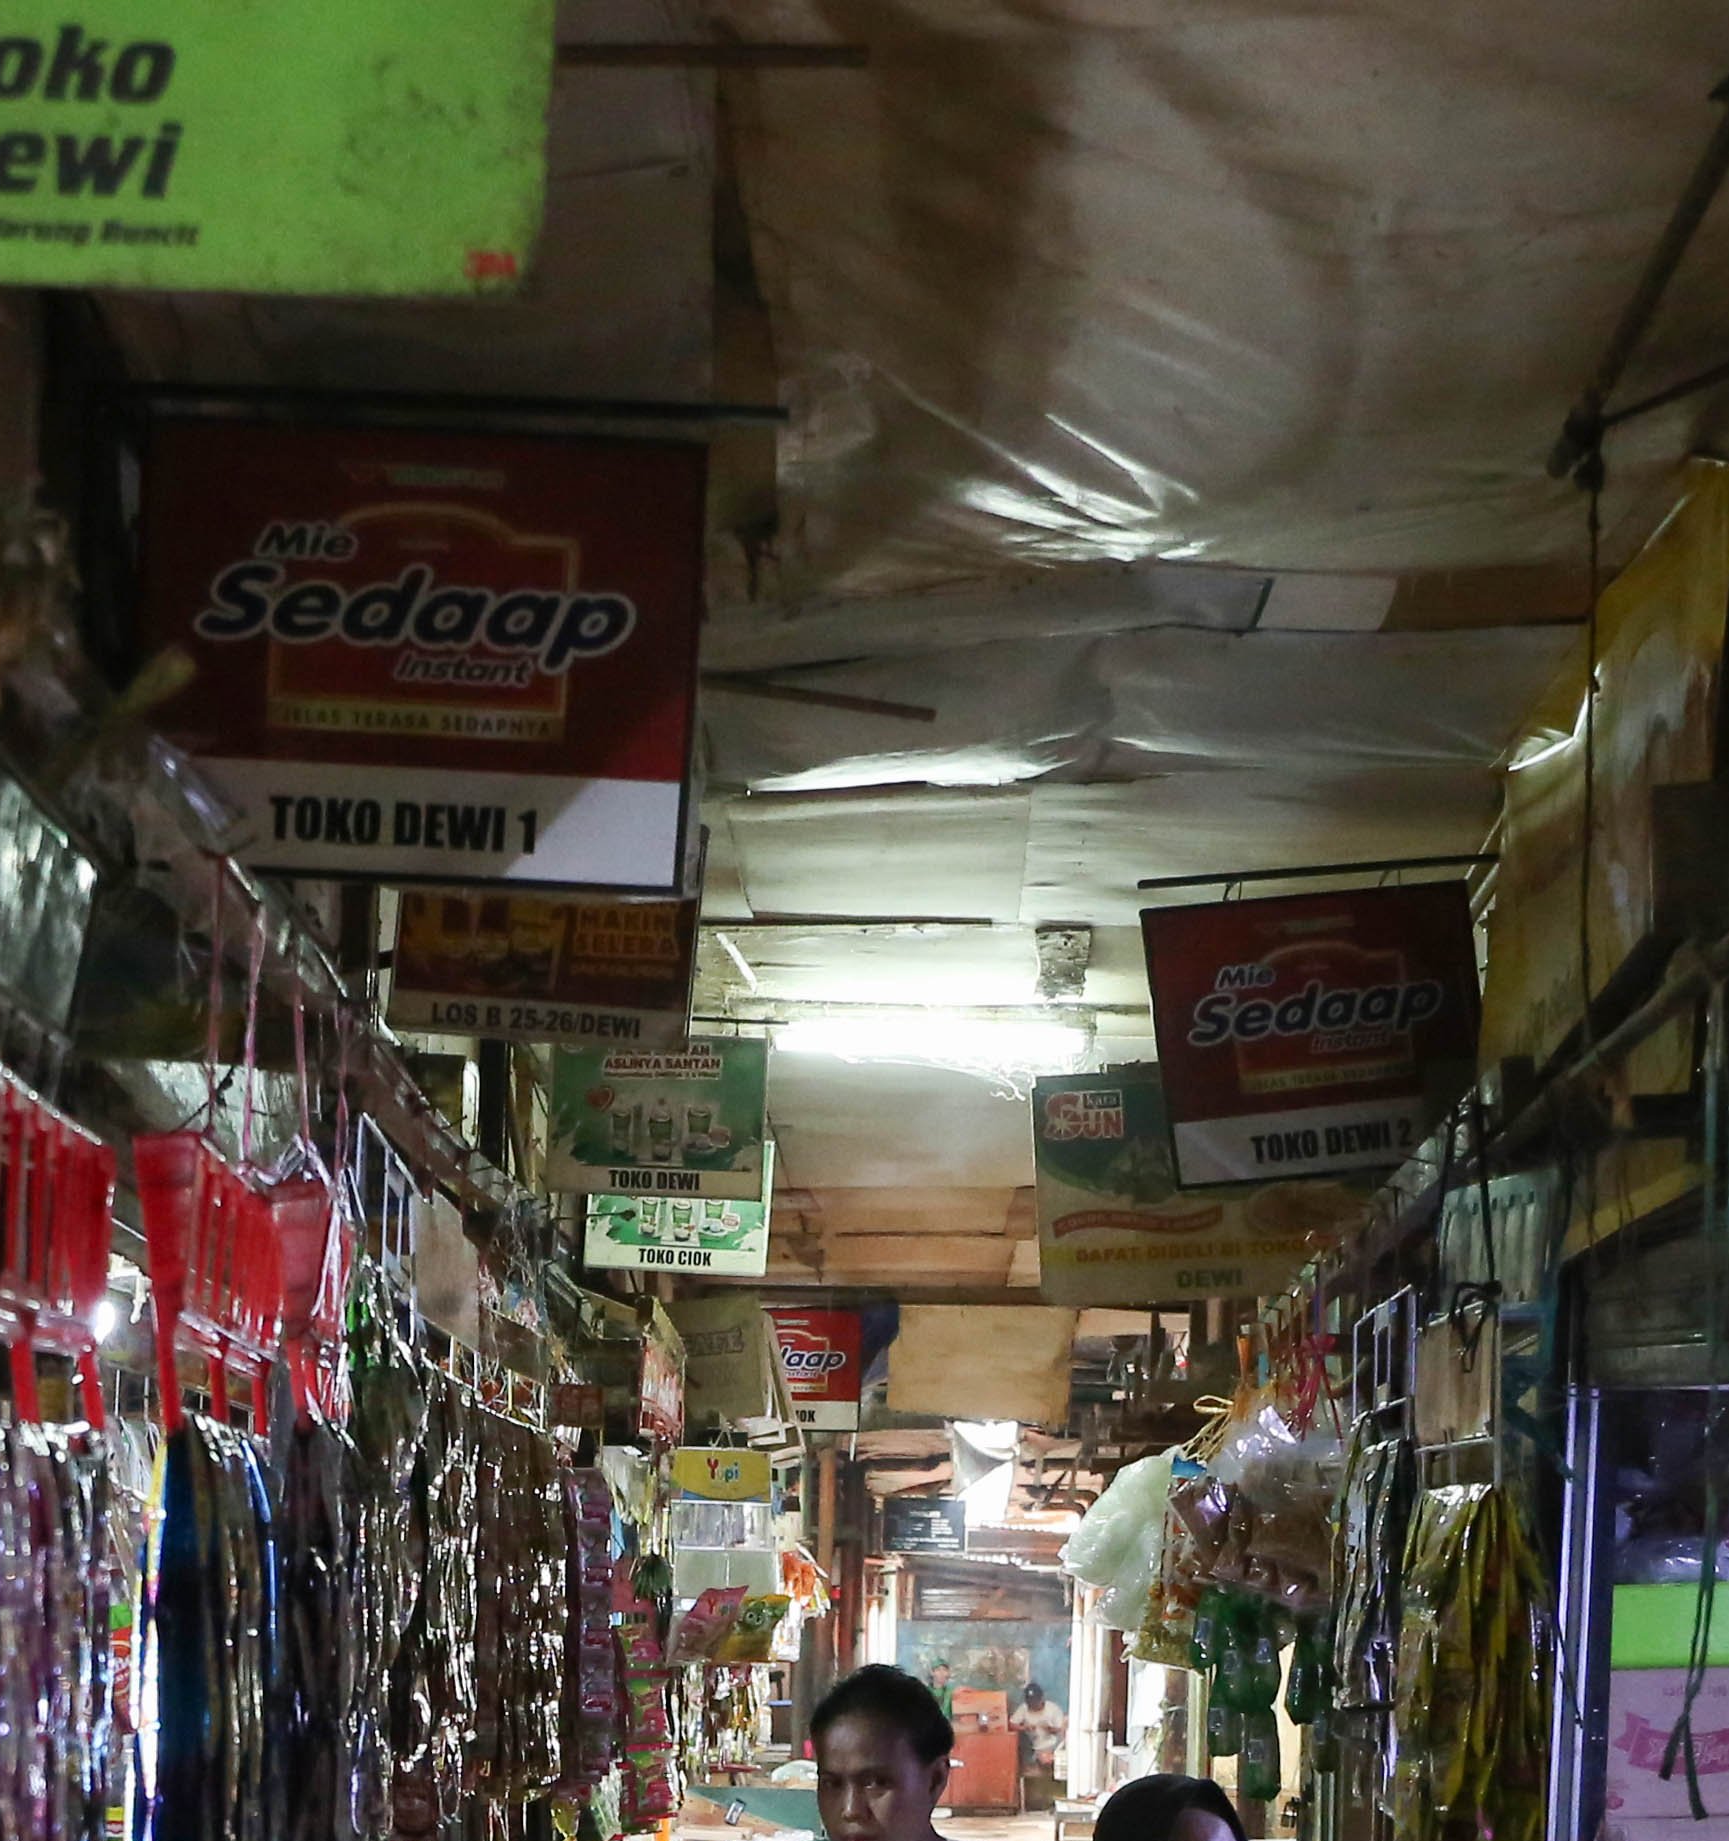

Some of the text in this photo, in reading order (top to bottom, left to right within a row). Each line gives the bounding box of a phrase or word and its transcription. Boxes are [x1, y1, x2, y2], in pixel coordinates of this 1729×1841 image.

[255, 521, 356, 560] Mie
[194, 559, 636, 674] Sedaap
[394, 651, 533, 688] Instant
[352, 706, 432, 732] TERASA
[441, 712, 552, 738] SEDAPNYA
[269, 793, 539, 855] TOKO DEWI 1
[1215, 963, 1276, 990] Mie
[430, 1003, 477, 1027] LOS
[486, 1007, 502, 1028] B
[1187, 979, 1443, 1047] Sedaap
[604, 1058, 721, 1070] ASLINYA SANTAN
[1251, 1118, 1413, 1164] TOKO DEWI 2
[609, 1170, 700, 1191] TOKO DEWI
[639, 1248, 712, 1267] TOKO CIOK
[1176, 1268, 1243, 1290] DEWI
